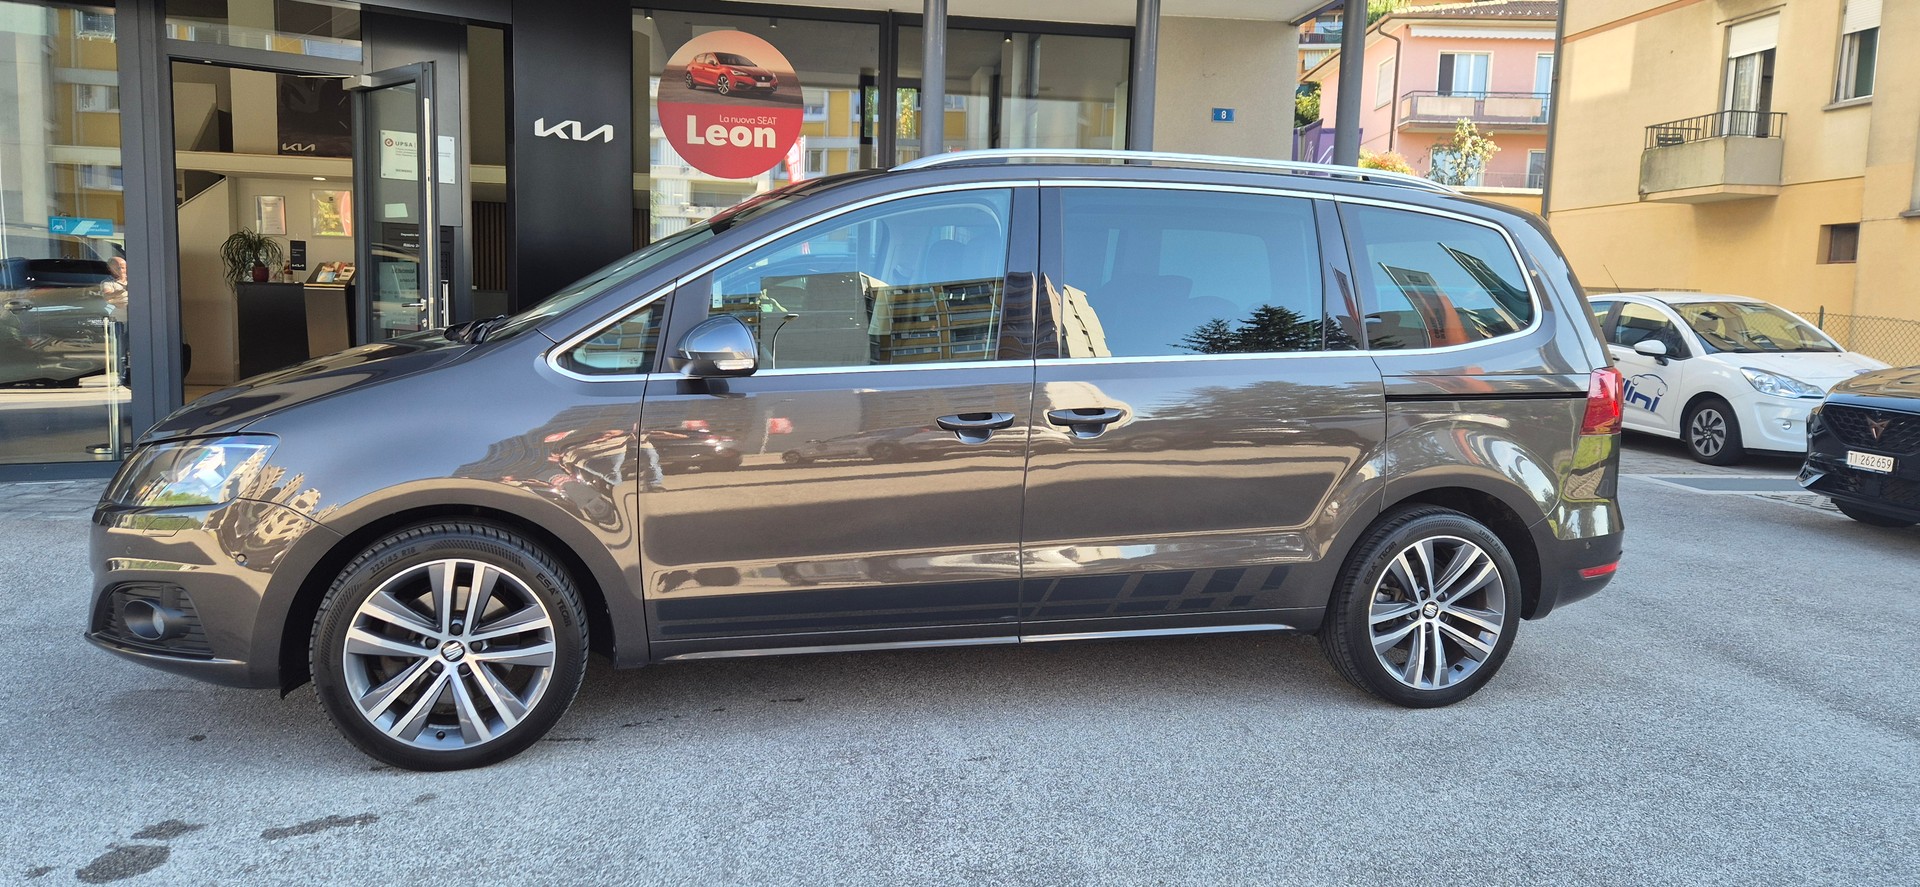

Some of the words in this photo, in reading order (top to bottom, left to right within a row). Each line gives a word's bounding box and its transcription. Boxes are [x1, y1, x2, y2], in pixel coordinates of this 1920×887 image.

[719, 114, 729, 123] La
[730, 116, 756, 124] nuova
[757, 116, 777, 125] SEAT
[1221, 110, 1227, 120] 8
[534, 117, 614, 144] KIA
[686, 114, 777, 149] Leon
[282, 142, 316, 152] KIA
[1849, 452, 1858, 465] TI
